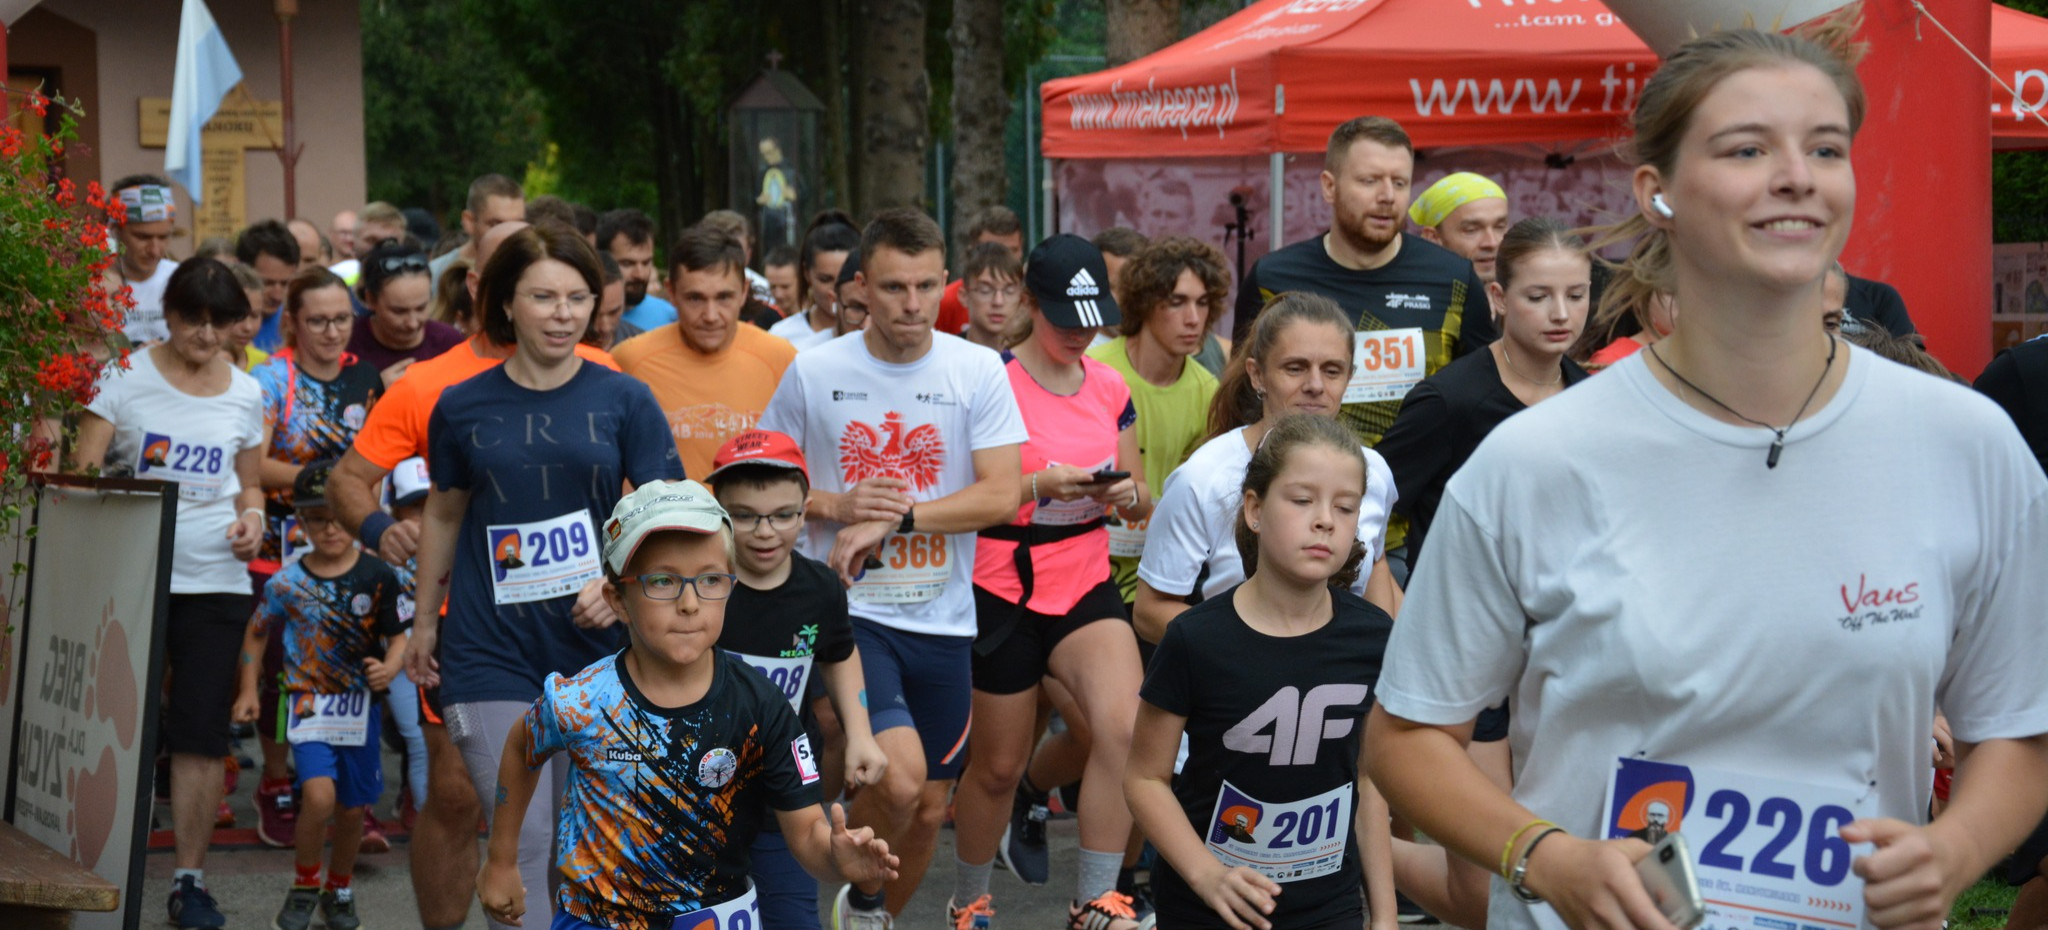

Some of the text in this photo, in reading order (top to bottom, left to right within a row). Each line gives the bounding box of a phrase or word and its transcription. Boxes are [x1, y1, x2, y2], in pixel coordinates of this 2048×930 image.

[1494, 13, 1624, 27] ...tam g
[1068, 67, 1239, 140] www.timekeeper.pl
[1408, 62, 1650, 117] www.ti
[1066, 285, 1099, 296] adidas
[1363, 335, 1415, 371] 351
[735, 432, 770, 446] STREET
[737, 441, 762, 452] WEAR
[172, 443, 223, 475] 228
[527, 521, 590, 567] 209
[889, 533, 947, 570] 368
[1840, 573, 1919, 614] Vans
[1865, 611, 1889, 625] The
[320, 688, 365, 716] 280
[1222, 683, 1368, 766] 4F
[609, 750, 642, 762] Kuba
[1267, 797, 1340, 849] 201
[1699, 789, 1855, 887] 226
